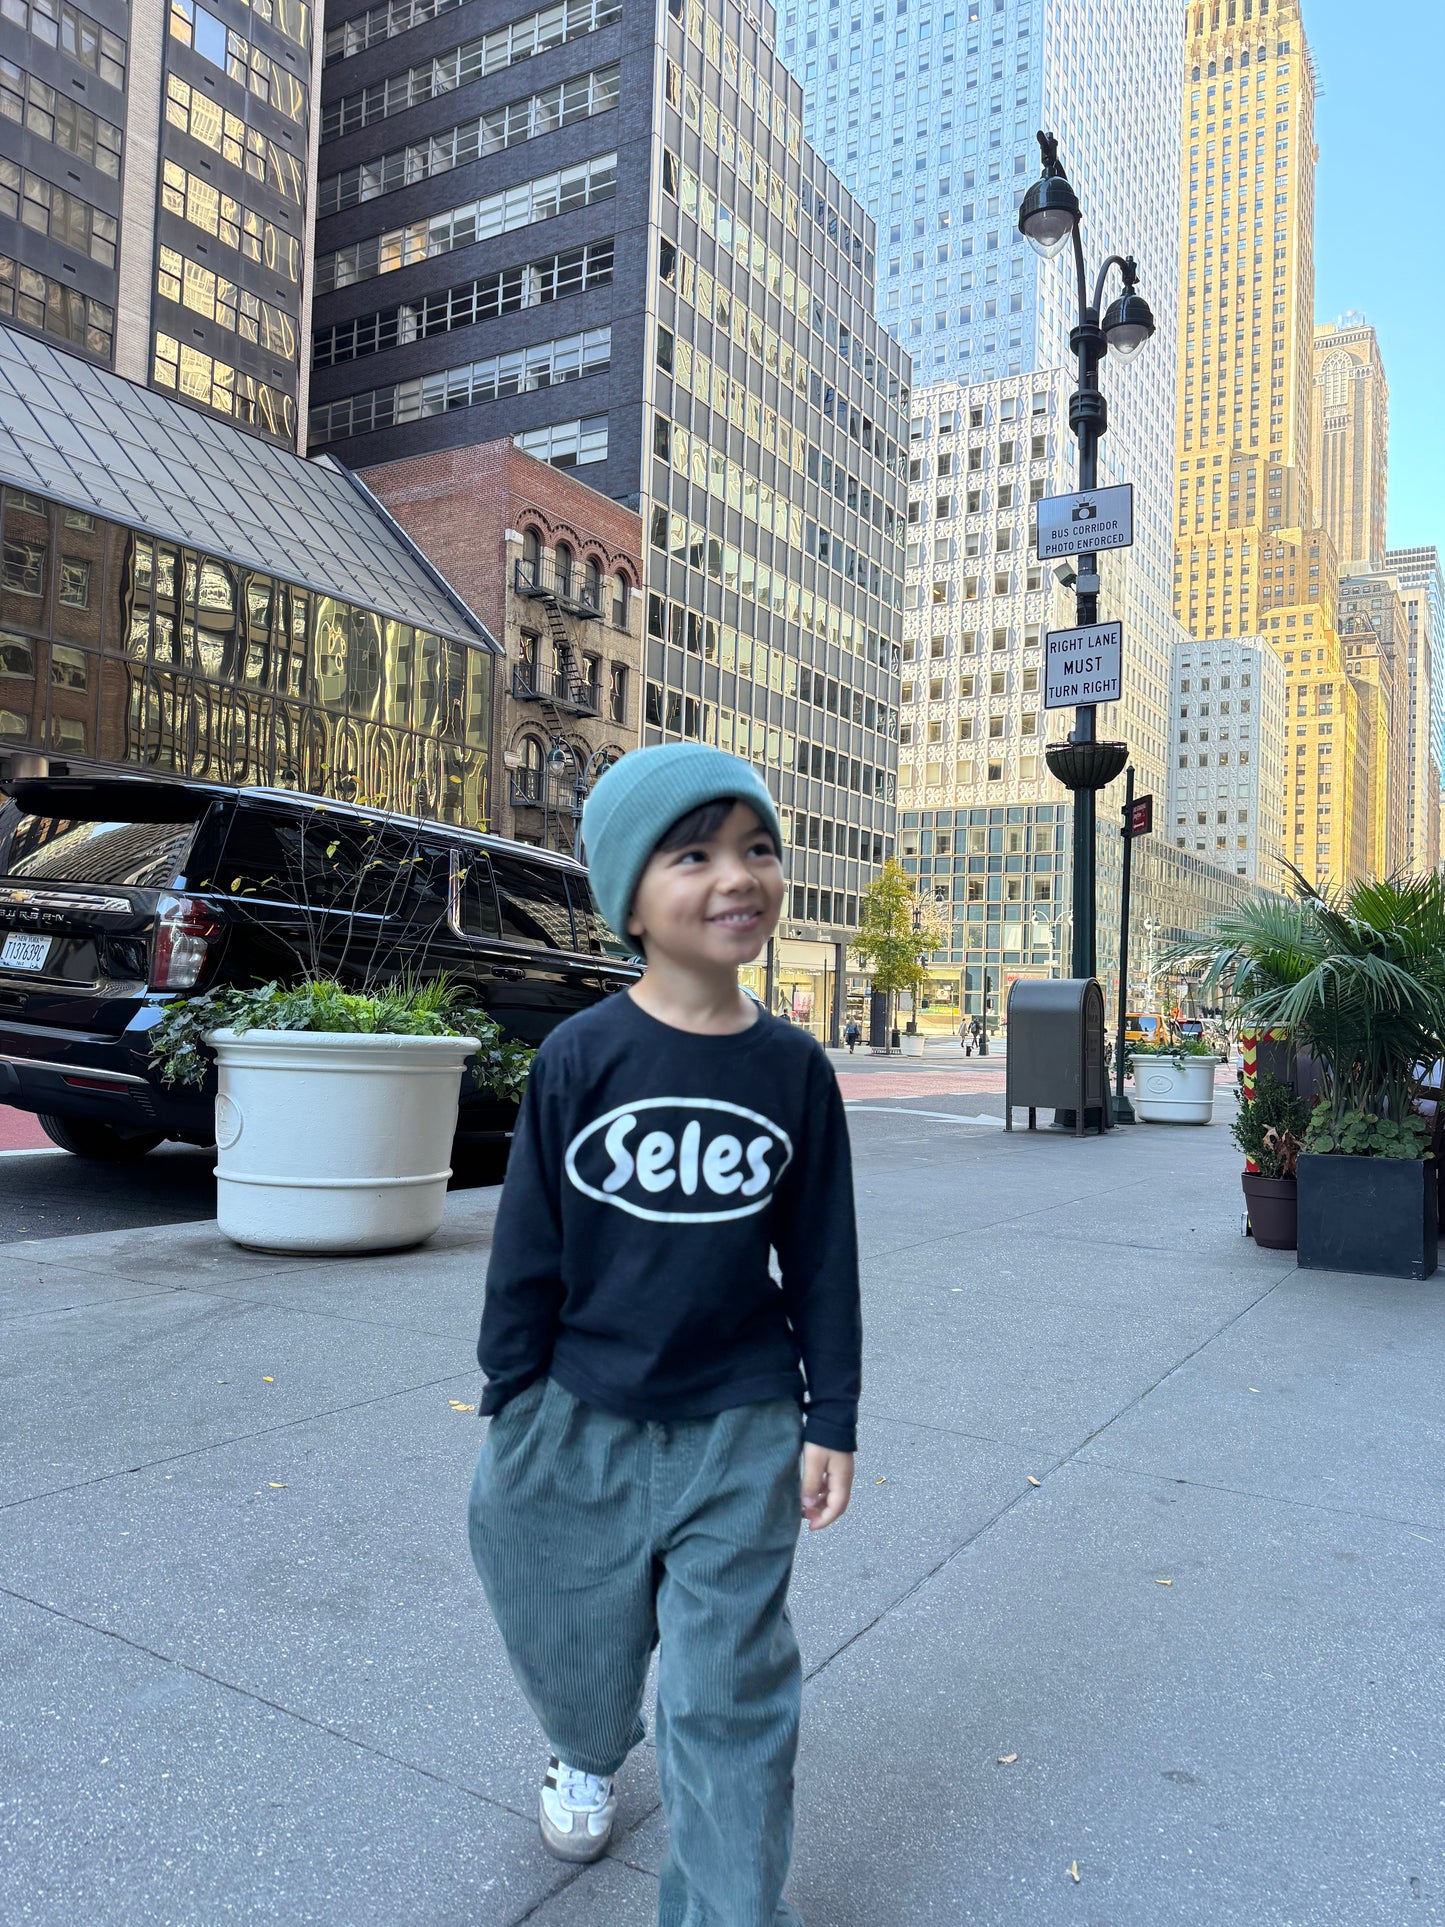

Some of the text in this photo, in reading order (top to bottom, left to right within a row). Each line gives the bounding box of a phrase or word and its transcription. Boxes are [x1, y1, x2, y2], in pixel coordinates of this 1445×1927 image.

[1051, 520, 1118, 540] BUS CORRIDOR
[1045, 533, 1124, 554] PHOTO ENFORCED
[1050, 632, 1118, 654] RIGHT LANE
[1064, 656, 1102, 676] MUST
[1049, 679, 1117, 699] TURN RIGHT
[4, 941, 45, 962] T137639C
[602, 1114, 774, 1197] Seles
